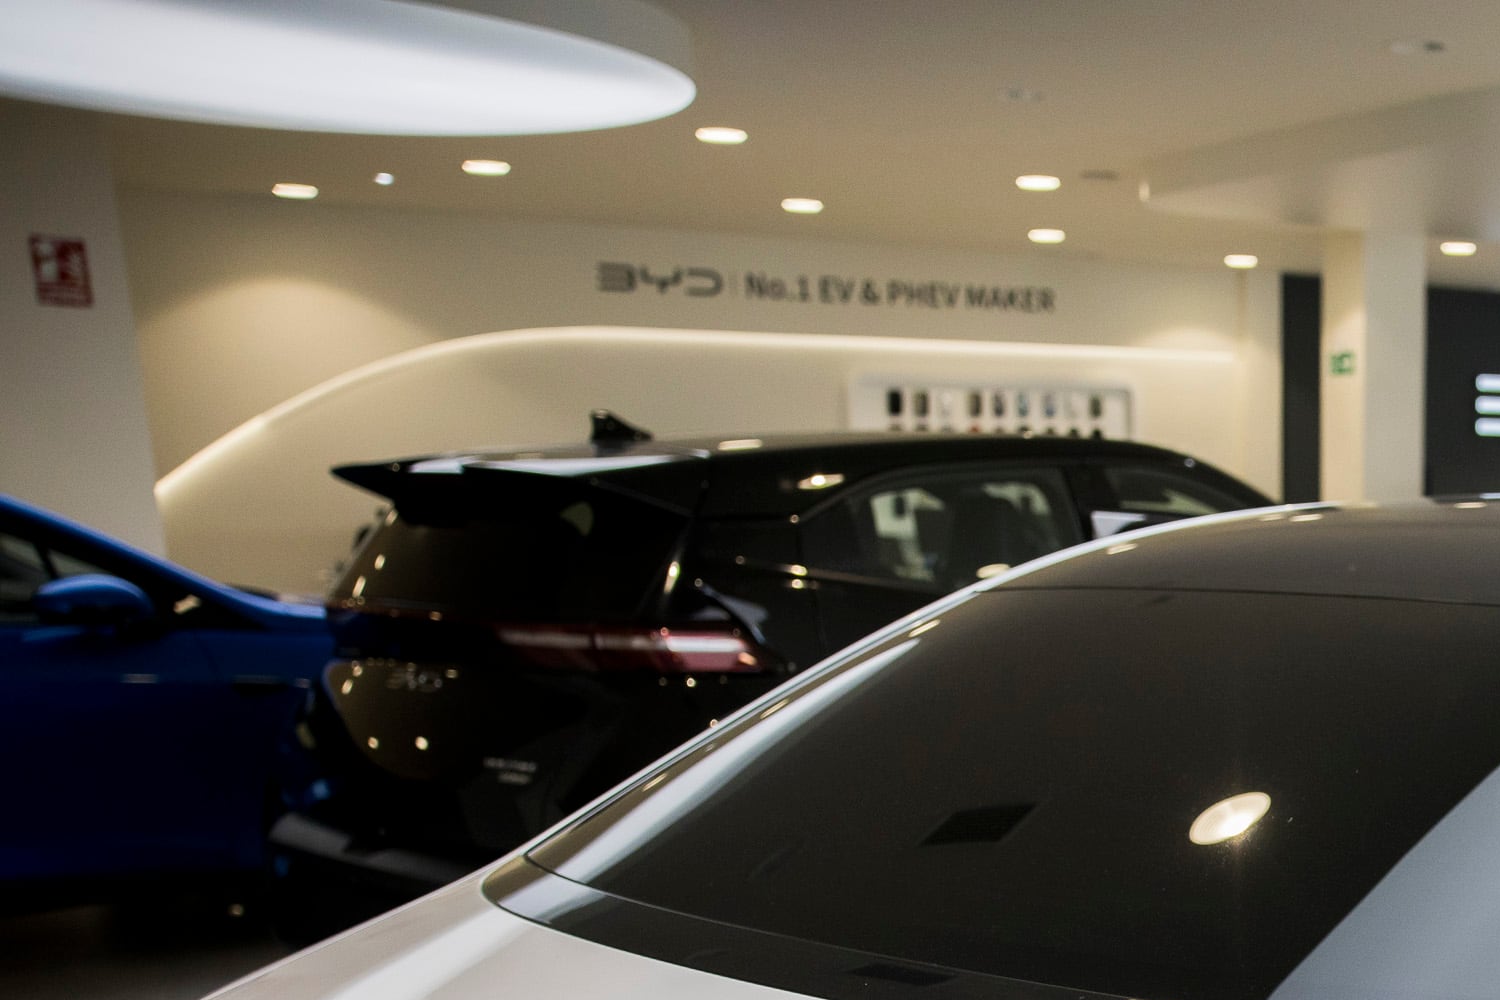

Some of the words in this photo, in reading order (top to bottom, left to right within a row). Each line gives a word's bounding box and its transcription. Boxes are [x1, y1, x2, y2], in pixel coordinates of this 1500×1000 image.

[596, 261, 724, 297] BYD
[817, 276, 854, 304] EV
[860, 278, 881, 306] &
[887, 280, 960, 309] PHEV
[964, 285, 1057, 314] MAKER
